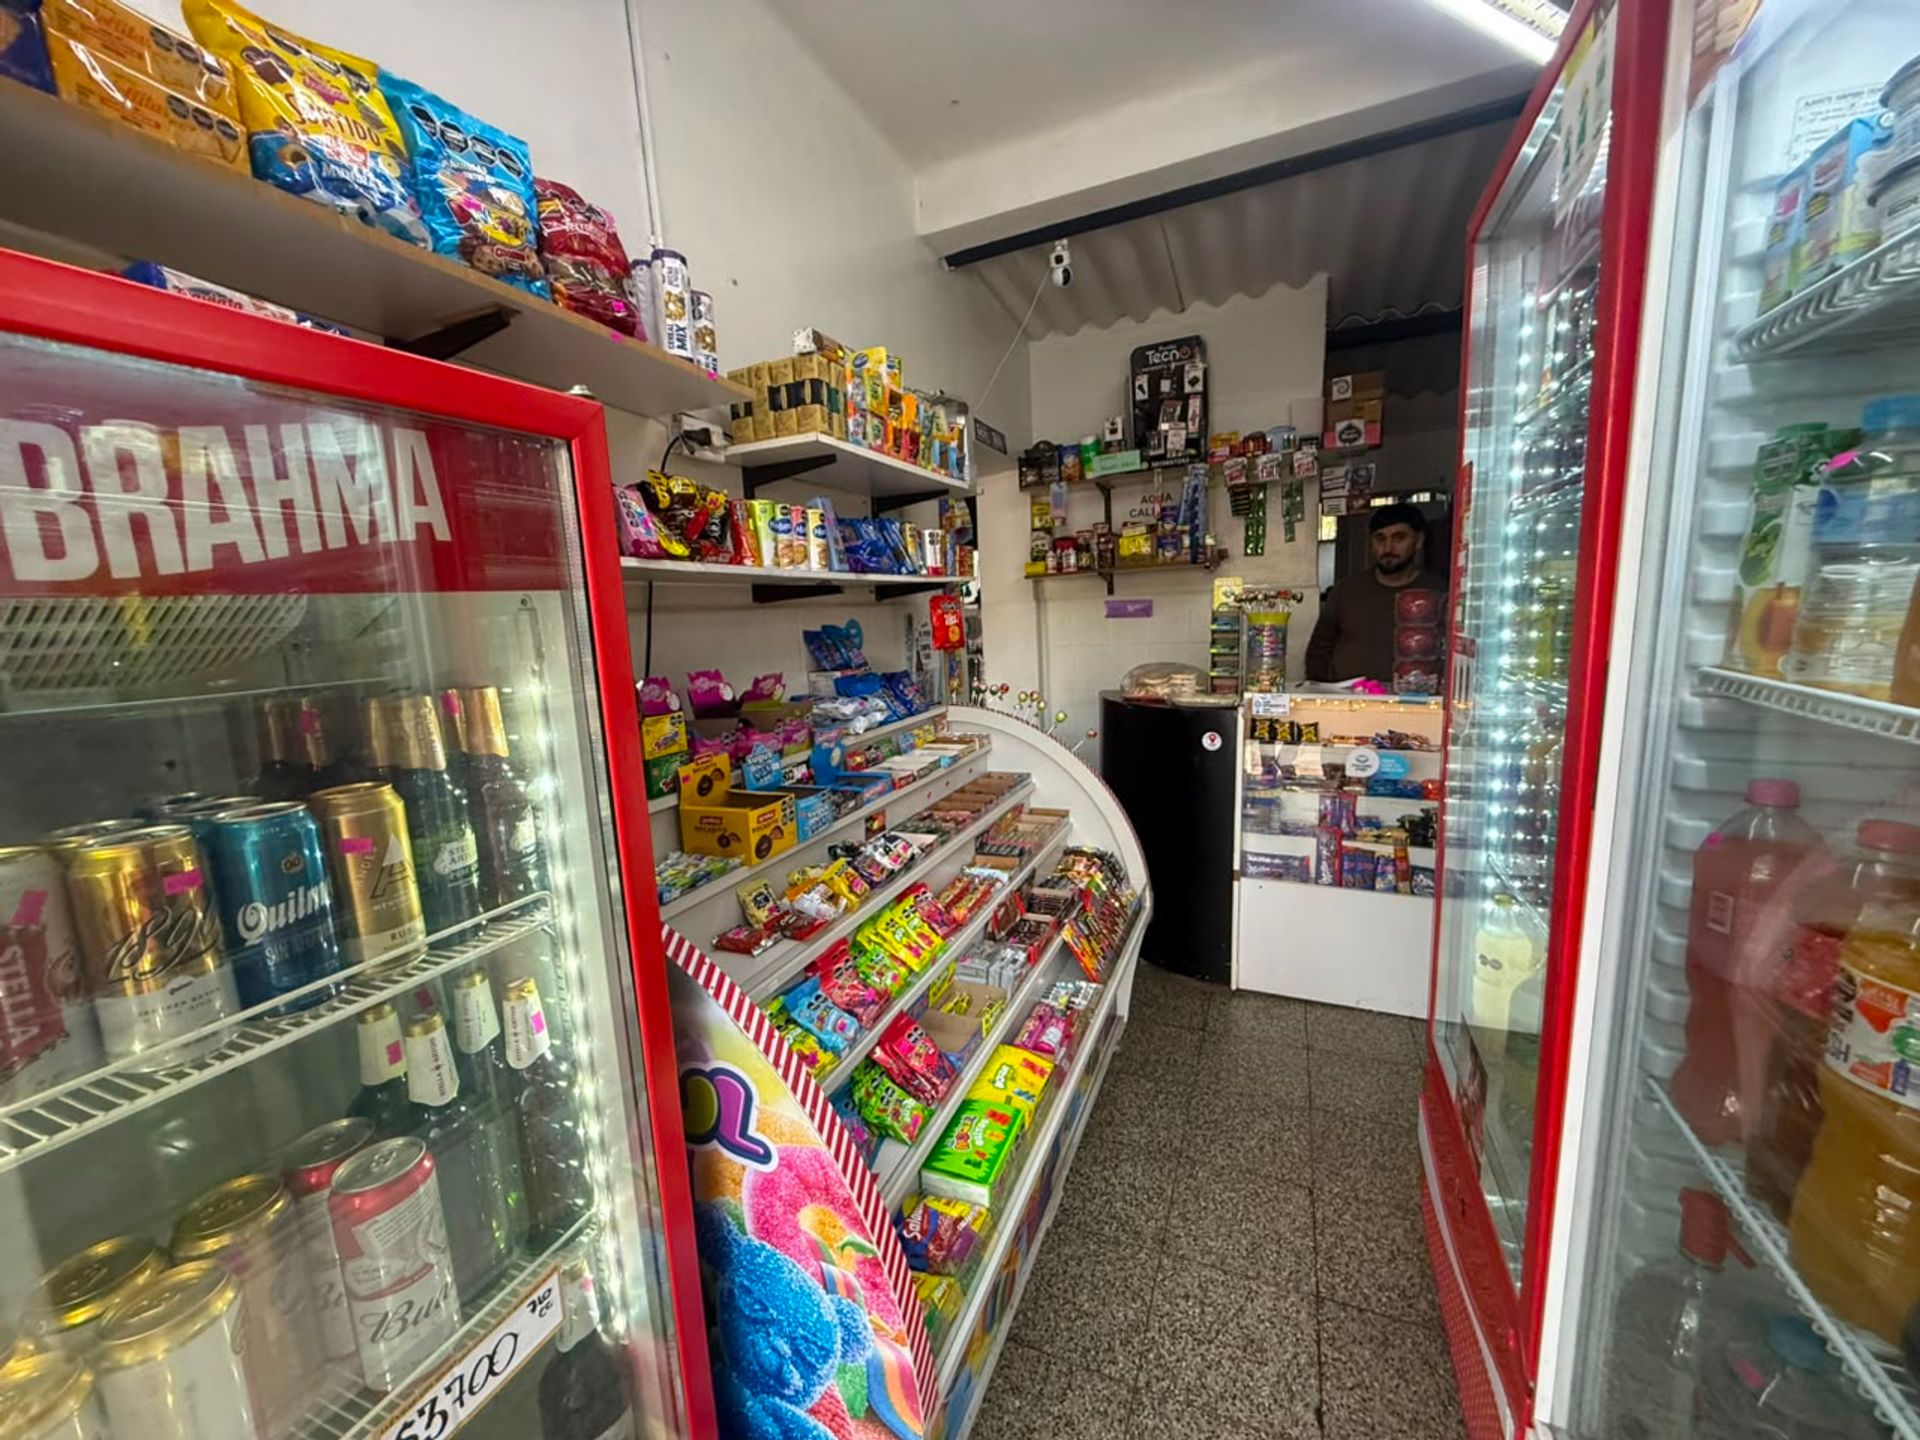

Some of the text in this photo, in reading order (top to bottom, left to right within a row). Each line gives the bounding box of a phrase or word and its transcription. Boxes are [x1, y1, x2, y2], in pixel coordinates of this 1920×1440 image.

[676, 325, 688, 351] MIX
[0, 418, 452, 581] BRAHMA
[0, 944, 42, 1047] STELLA
